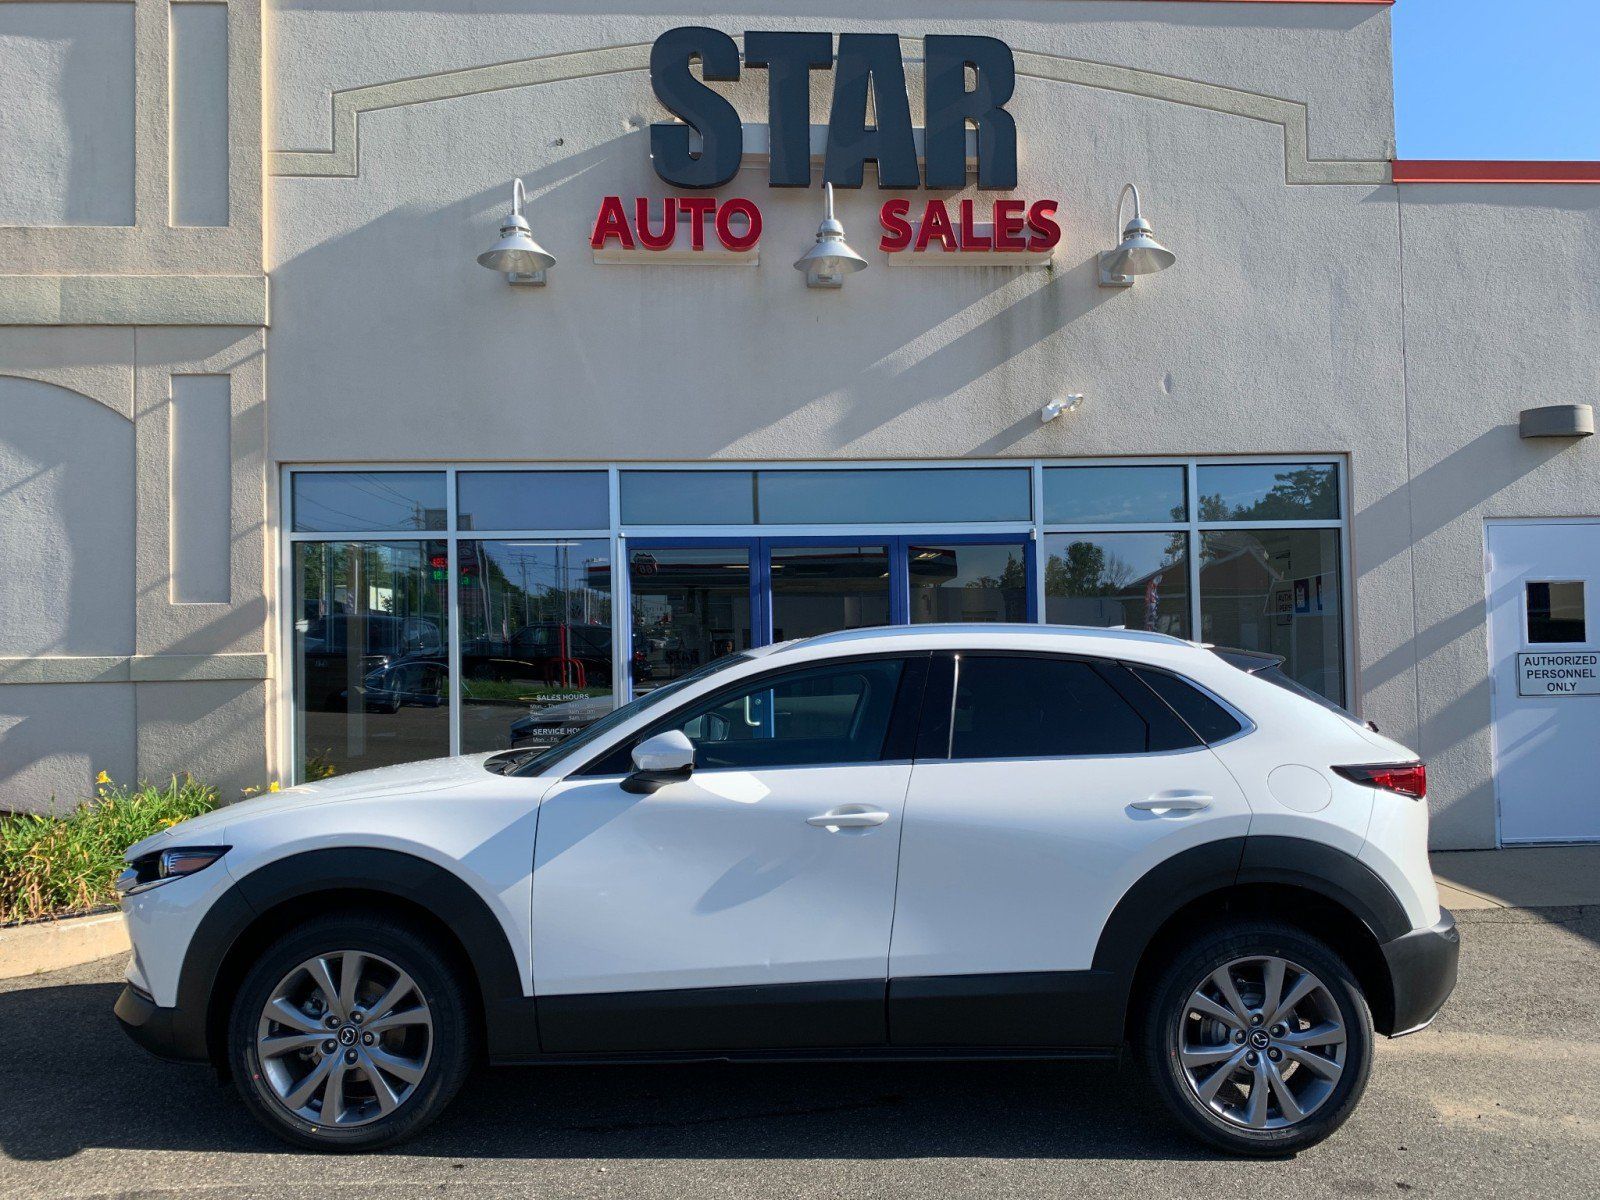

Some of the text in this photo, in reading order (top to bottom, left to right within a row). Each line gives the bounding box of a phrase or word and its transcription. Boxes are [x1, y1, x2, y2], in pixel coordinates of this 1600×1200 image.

[650, 26, 1017, 189] STAR
[591, 196, 1062, 253] AUTO SALES
[1524, 655, 1597, 666] AUTHORIZED
[1527, 669, 1596, 679] PERSONNEL
[1546, 682, 1577, 692] ONLY
[562, 693, 590, 701] HOURS
